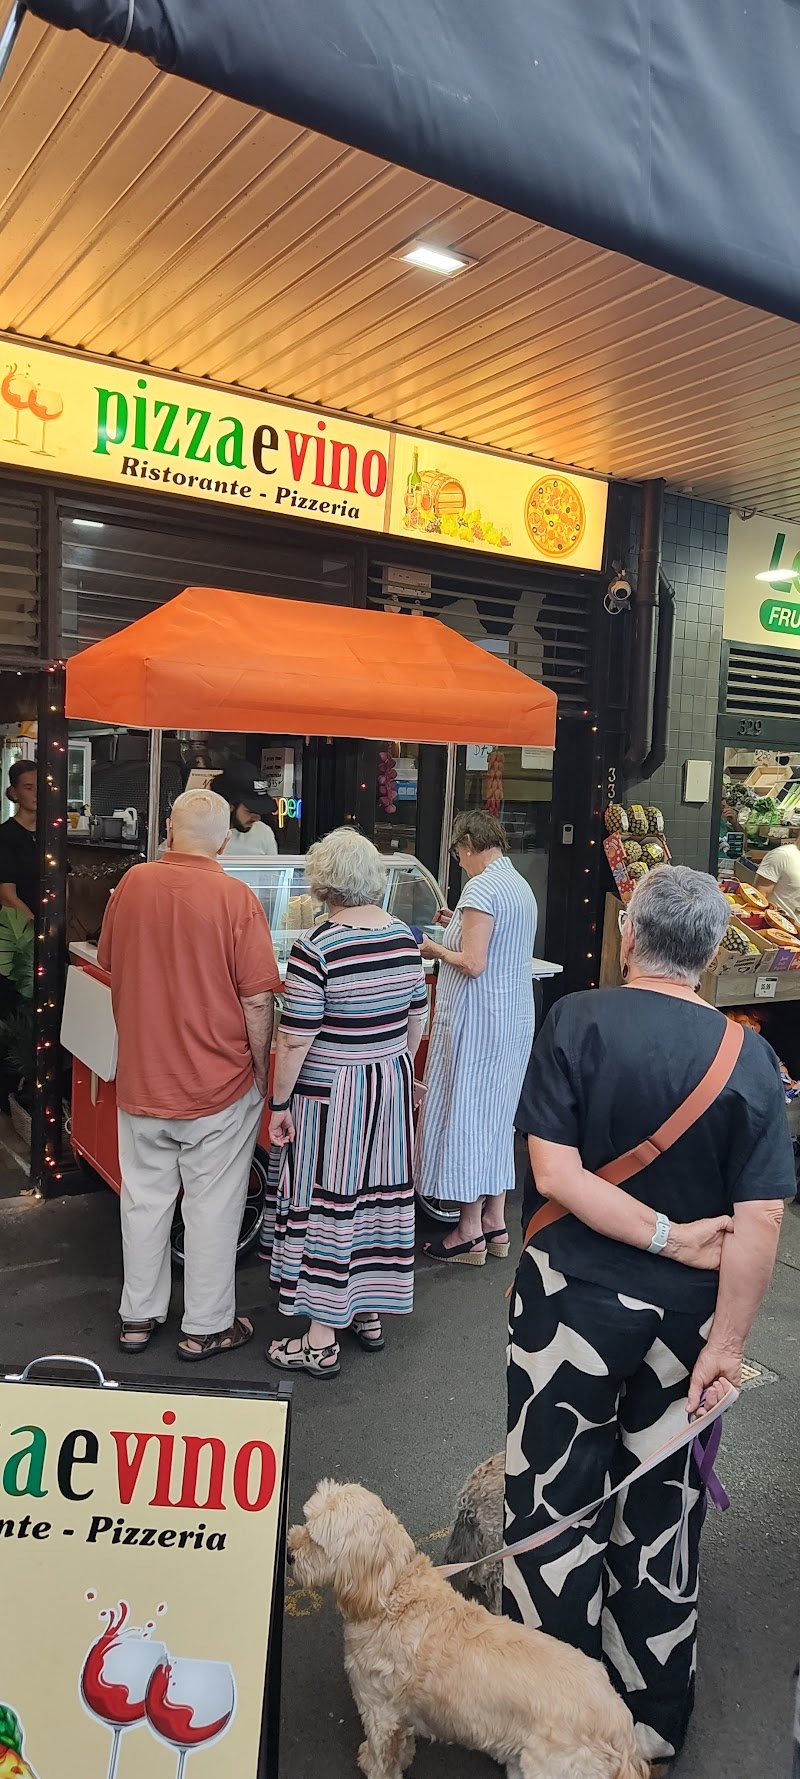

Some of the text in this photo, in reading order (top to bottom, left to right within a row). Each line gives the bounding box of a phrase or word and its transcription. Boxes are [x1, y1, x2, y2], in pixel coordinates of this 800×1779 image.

[120, 456, 253, 499] Ristorante
[275, 487, 361, 520] Pizzeria
[768, 532, 800, 594] L
[768, 606, 800, 628] FRU
[737, 718, 762, 737] 329
[607, 767, 616, 804] 33
[0, 1516, 51, 1541] nte
[86, 1516, 227, 1552] Pizzeria
